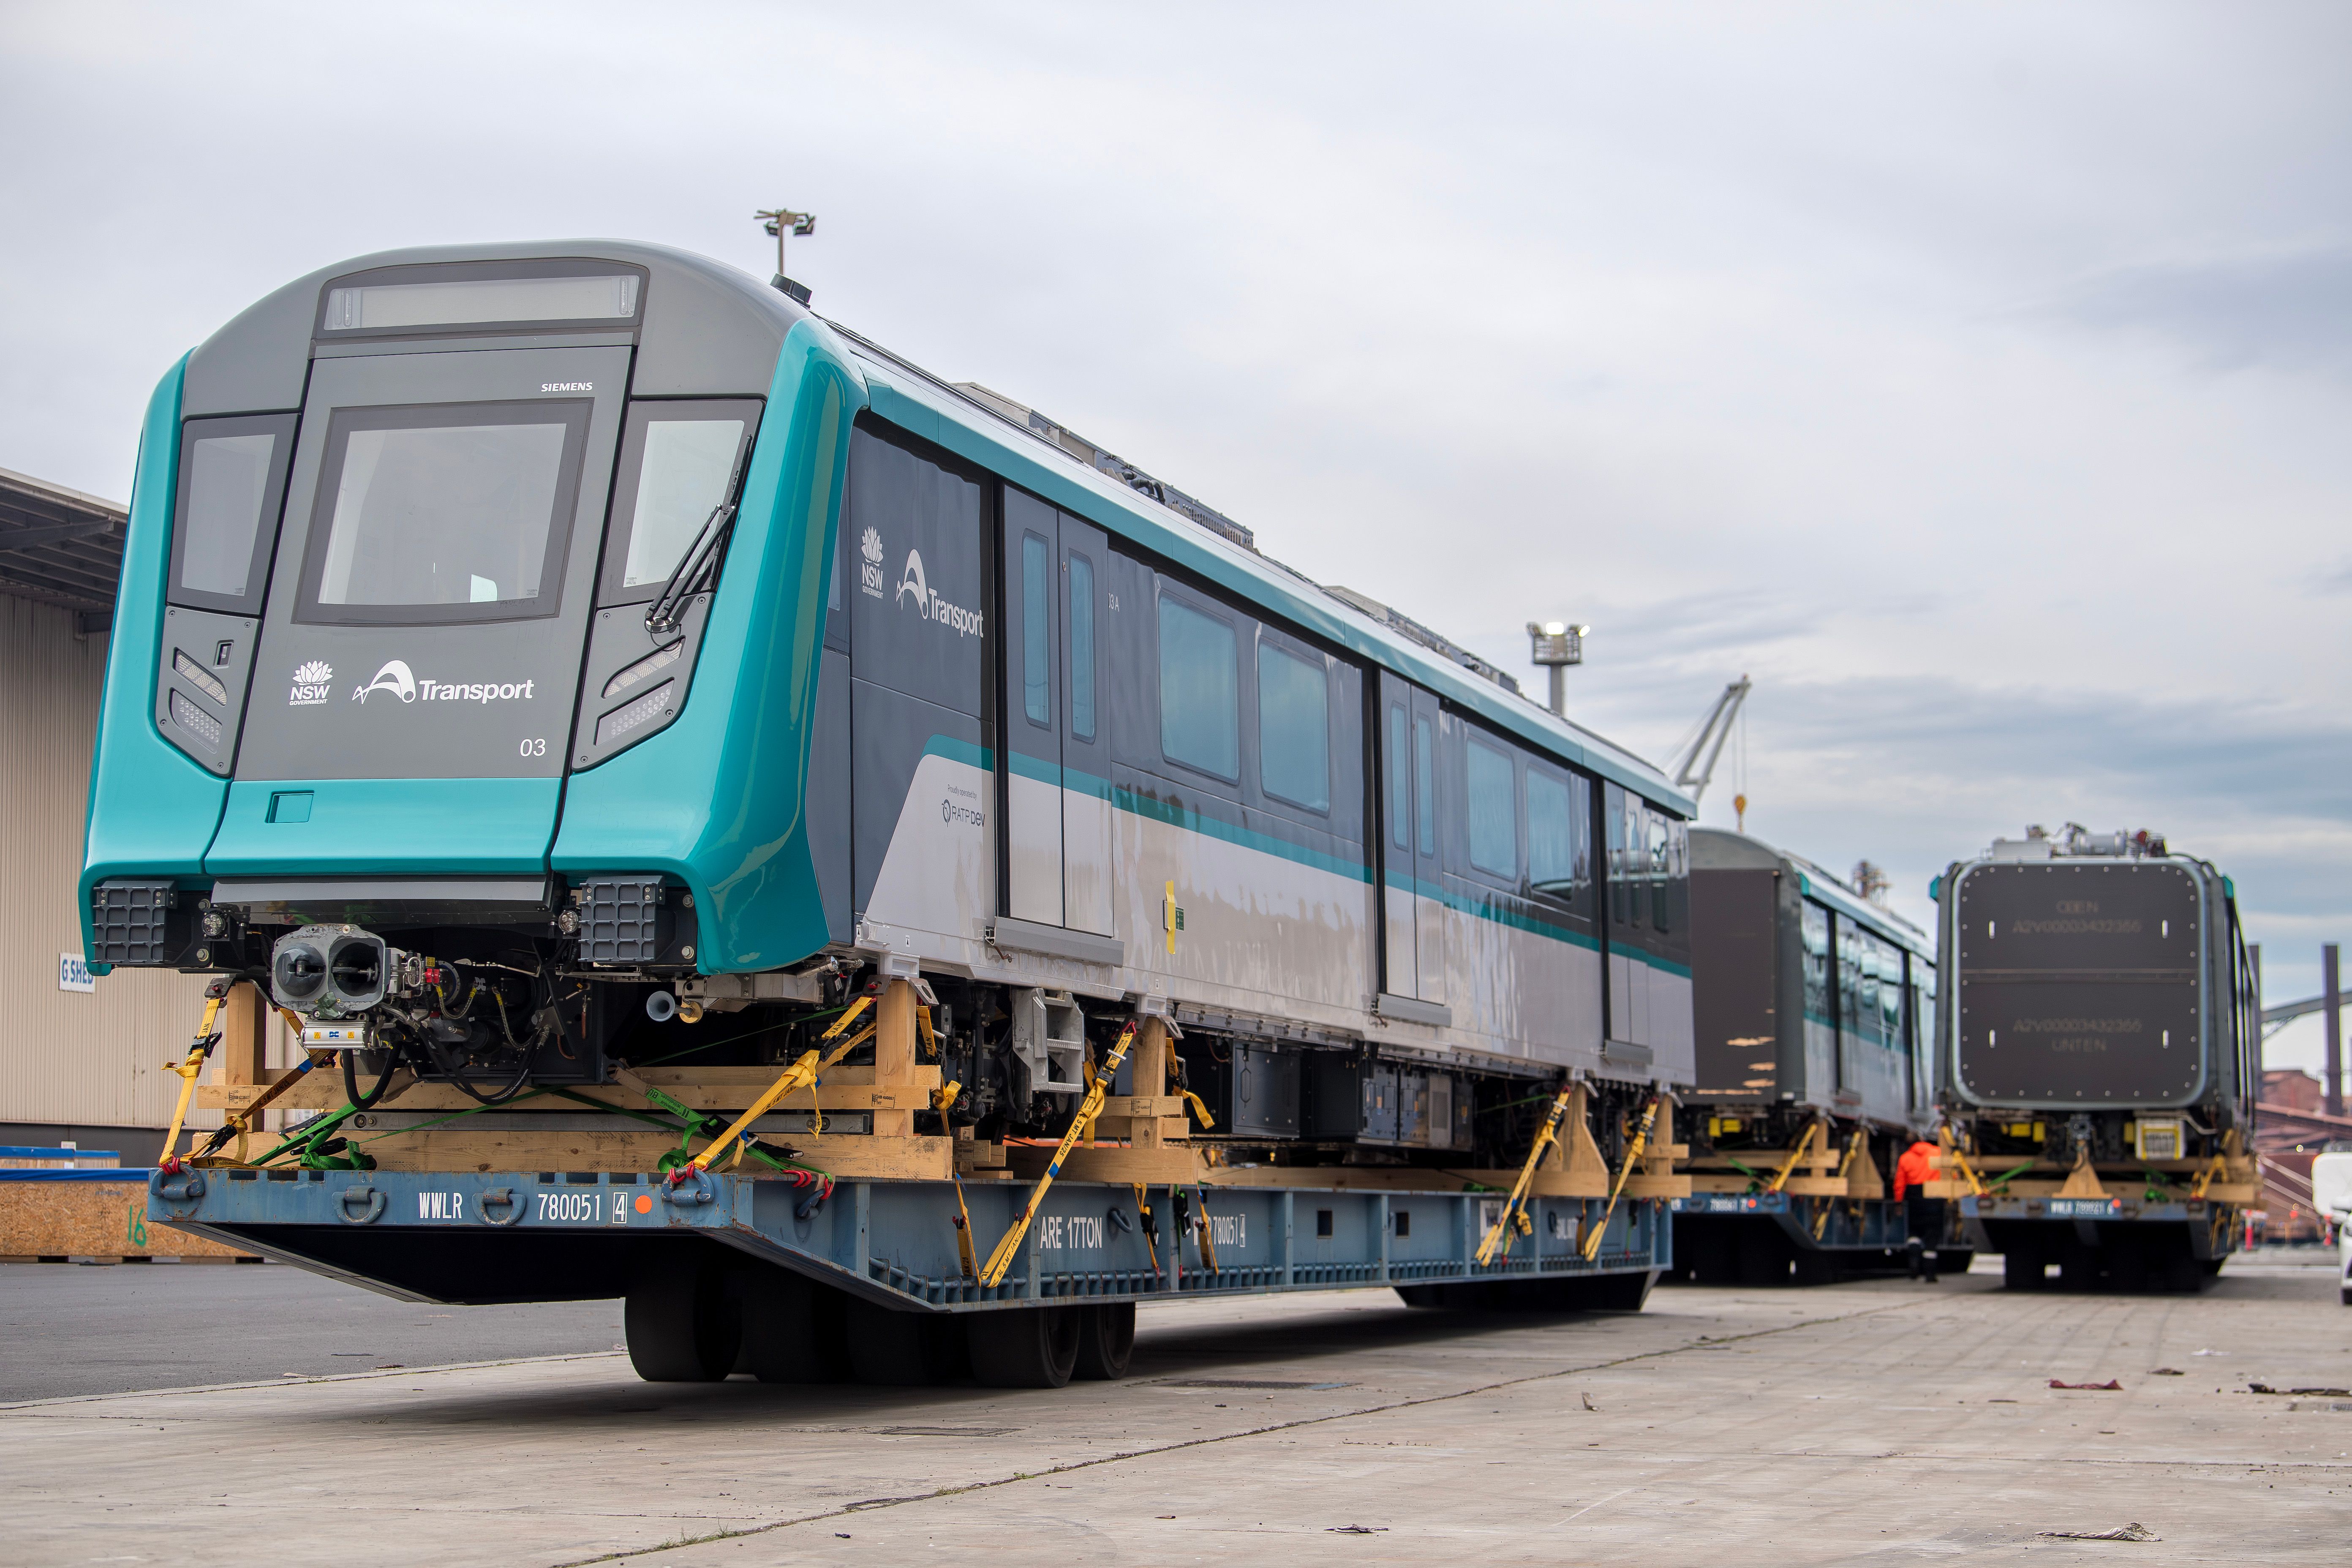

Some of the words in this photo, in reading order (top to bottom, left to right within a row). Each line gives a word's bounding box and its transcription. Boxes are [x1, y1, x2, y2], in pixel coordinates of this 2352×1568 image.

[541, 382, 593, 392] SIEMENS
[862, 563, 883, 591] NSW
[862, 585, 884, 600] GOVERNMENT
[928, 588, 983, 638] Transport
[1115, 596, 1119, 612] A
[290, 685, 330, 700] NSW
[419, 679, 534, 704] Transport
[520, 738, 546, 757] 03
[947, 784, 959, 796] Proudly
[959, 789, 973, 798] operated
[973, 791, 977, 800] by
[952, 806, 970, 823] RATP
[62, 958, 68, 982] G
[201, 1023, 210, 1033] JAN
[830, 1022, 845, 1033] JAN
[1072, 1124, 1080, 1135] MT
[1059, 1134, 1073, 1157] JAN/25
[419, 1192, 463, 1219] WWLR
[538, 1193, 601, 1221] 780051
[614, 1194, 626, 1222] 4
[128, 1205, 147, 1247] 16
[1067, 1217, 1102, 1249] 17TON
[1213, 1216, 1238, 1245] 780051
[1240, 1215, 1245, 1247] 4
[1005, 1252, 1013, 1264] MT
